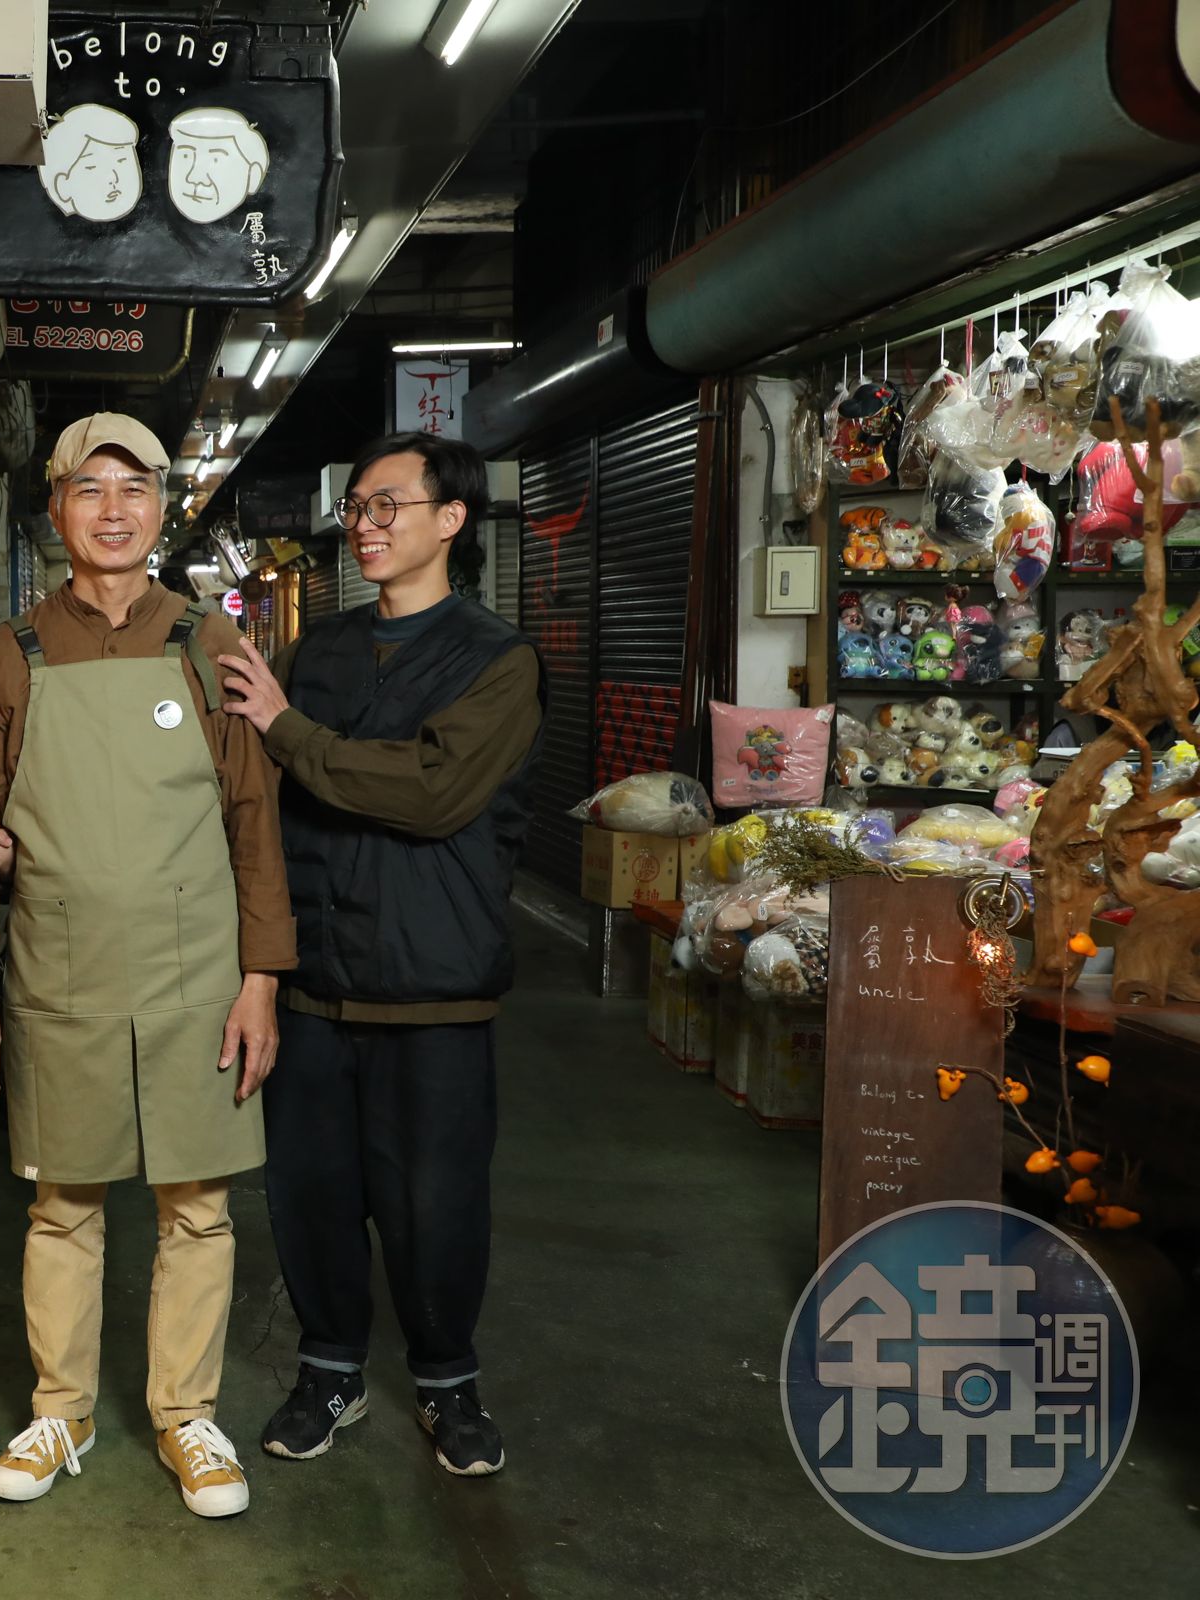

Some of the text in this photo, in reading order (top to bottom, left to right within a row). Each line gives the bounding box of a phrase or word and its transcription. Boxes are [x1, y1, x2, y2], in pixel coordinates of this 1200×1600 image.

[51, 22, 228, 70] belong
[5, 326, 144, 352] EL 5223026
[858, 984, 925, 1001] uncle
[860, 1083, 896, 1104] Belong
[861, 1127, 915, 1144] vintage
[864, 1154, 922, 1171] antique
[866, 1181, 903, 1200] pastry
